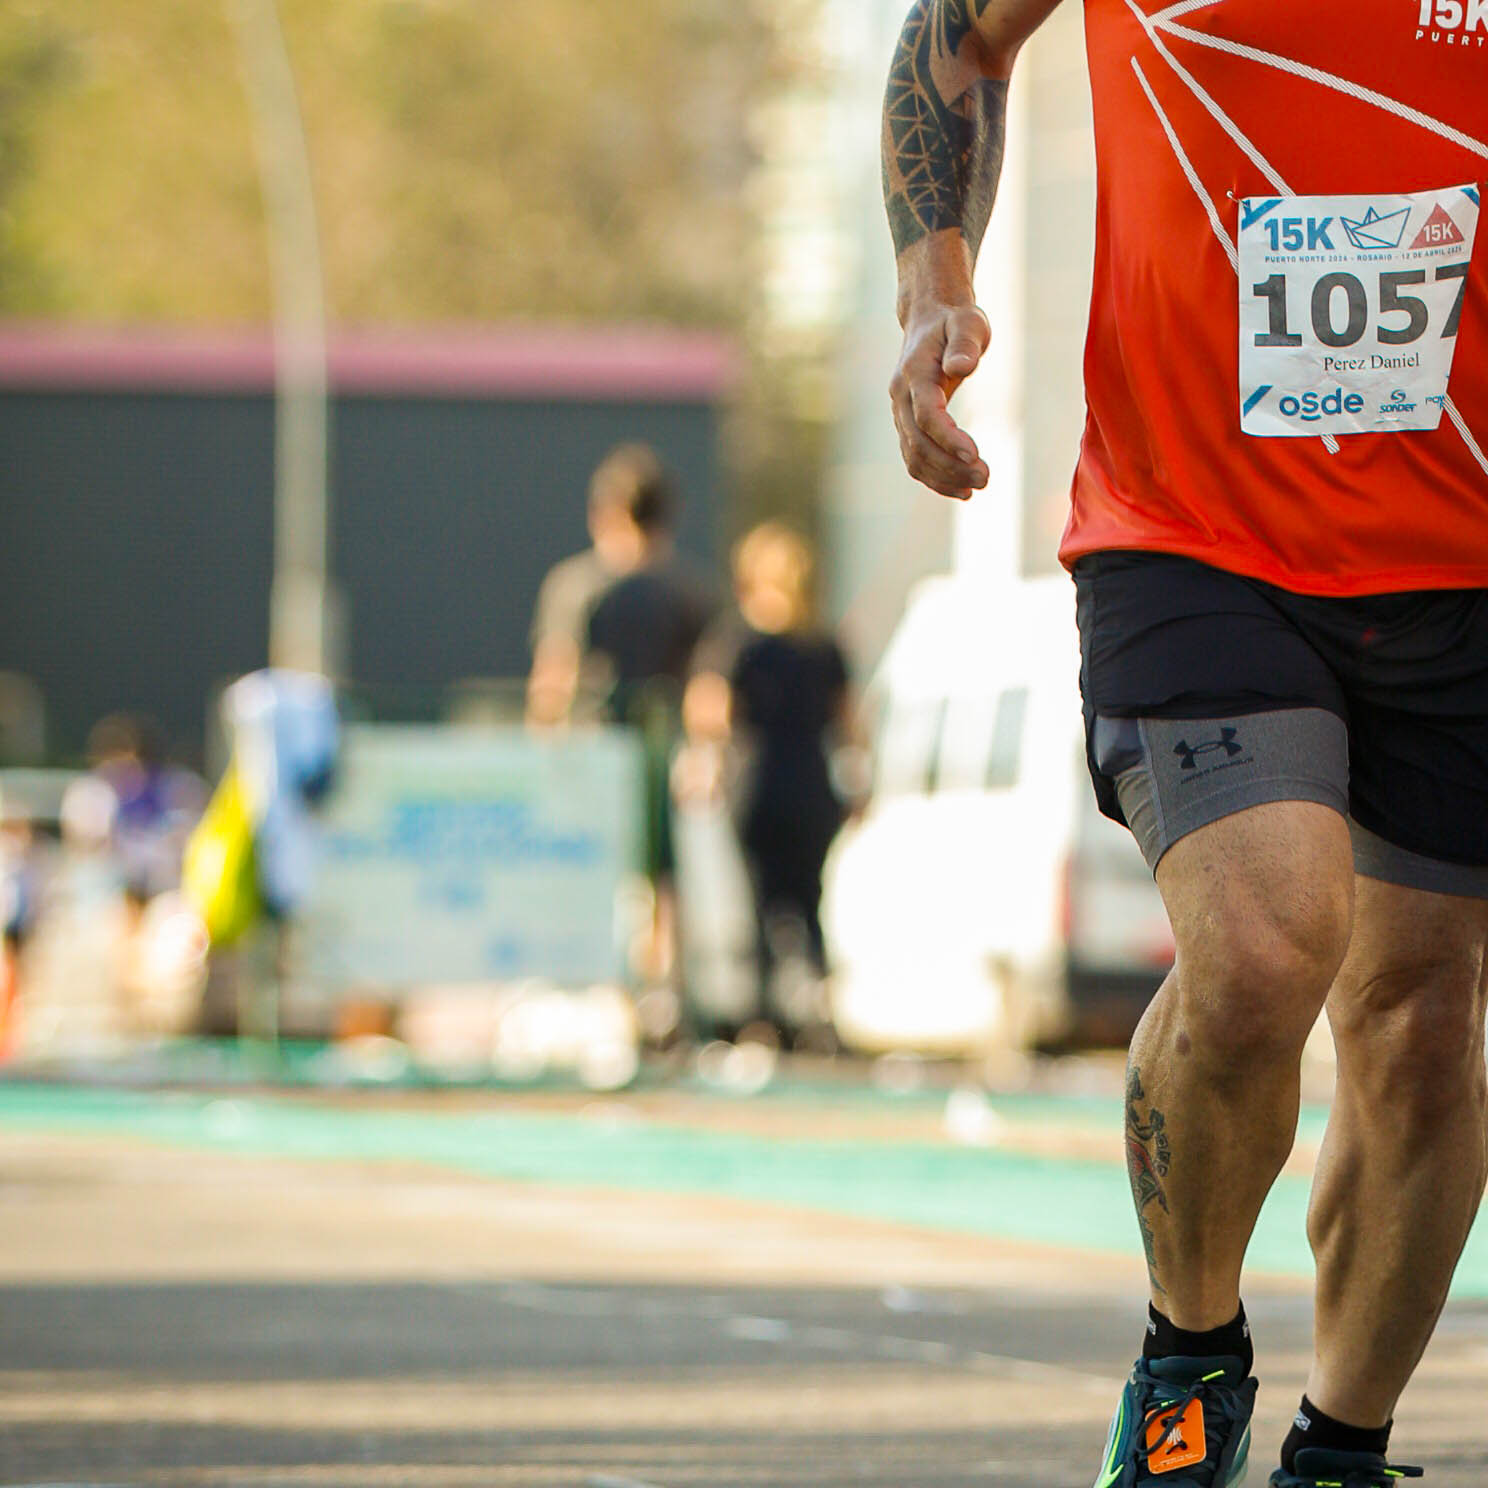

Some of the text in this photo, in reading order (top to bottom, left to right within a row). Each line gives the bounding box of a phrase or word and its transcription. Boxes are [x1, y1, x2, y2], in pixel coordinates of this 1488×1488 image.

[1264, 217, 1335, 251] 15K
[1423, 221, 1454, 243] 15K
[1265, 255, 1296, 263] PUERTO
[1299, 255, 1325, 263] NORTE
[1357, 253, 1392, 261] ROSARIO
[1253, 262, 1471, 348] 1057
[1324, 352, 1420, 371] Perez Daniel
[1279, 387, 1364, 418] osde
